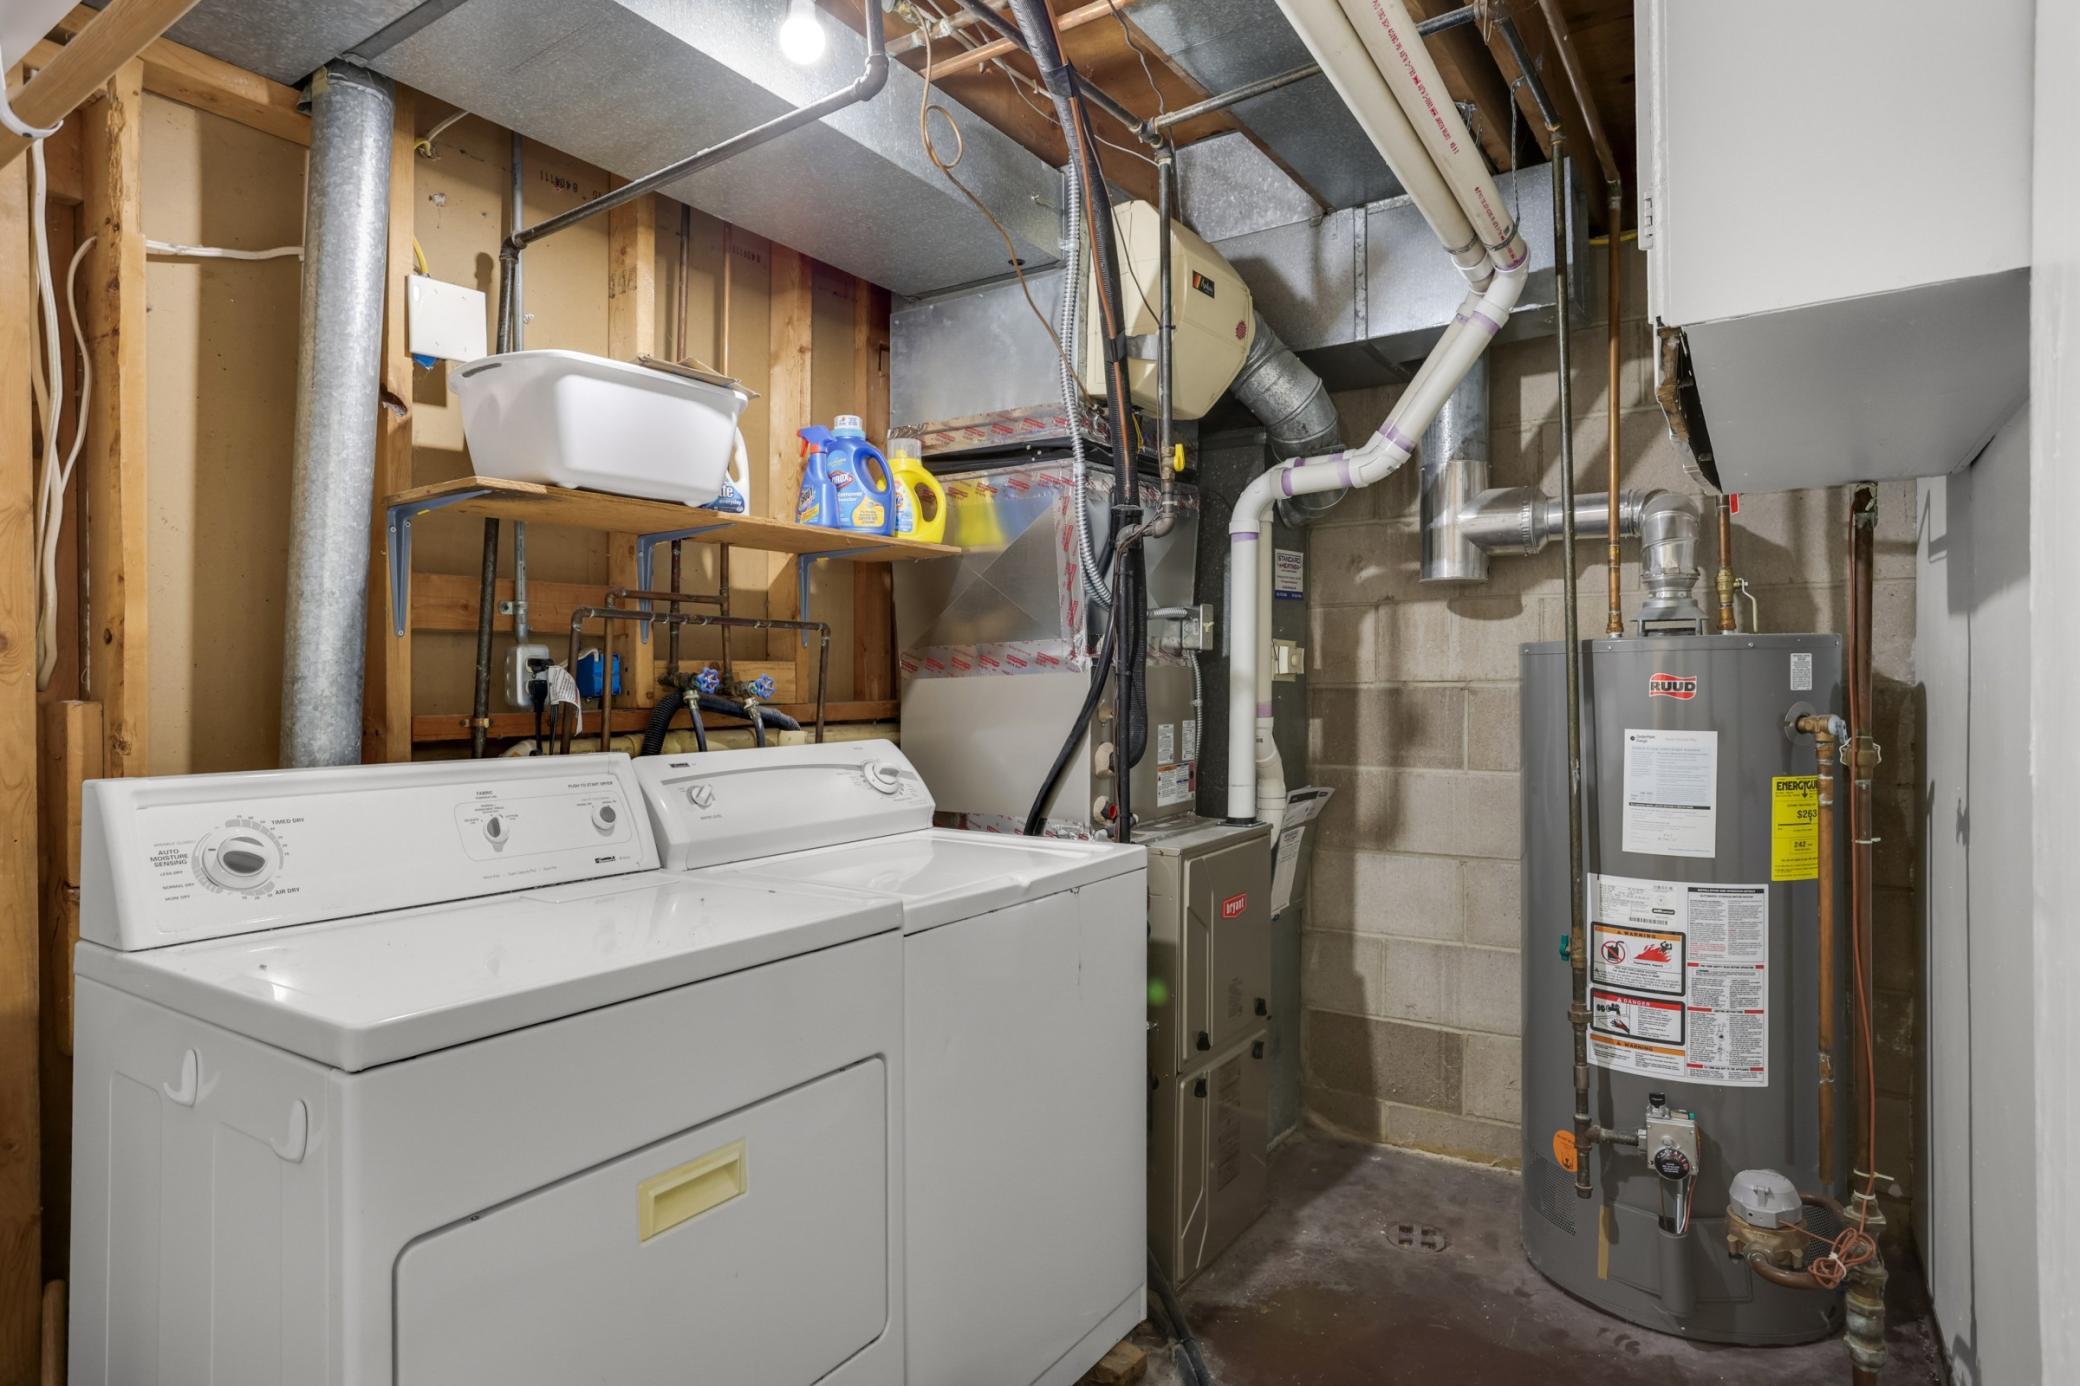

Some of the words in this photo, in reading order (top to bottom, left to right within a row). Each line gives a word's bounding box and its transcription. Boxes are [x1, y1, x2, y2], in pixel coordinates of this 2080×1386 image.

[1650, 681, 1696, 692] RUUD
[158, 848, 180, 856] AUTO
[150, 853, 188, 862] MOISTURE
[154, 860, 188, 868] SENSING
[1226, 896, 1244, 914] bryant
[1624, 930, 1657, 939] WARNING
[1623, 998, 1651, 1007] DANGER
[1624, 1042, 1654, 1052] WARNING
